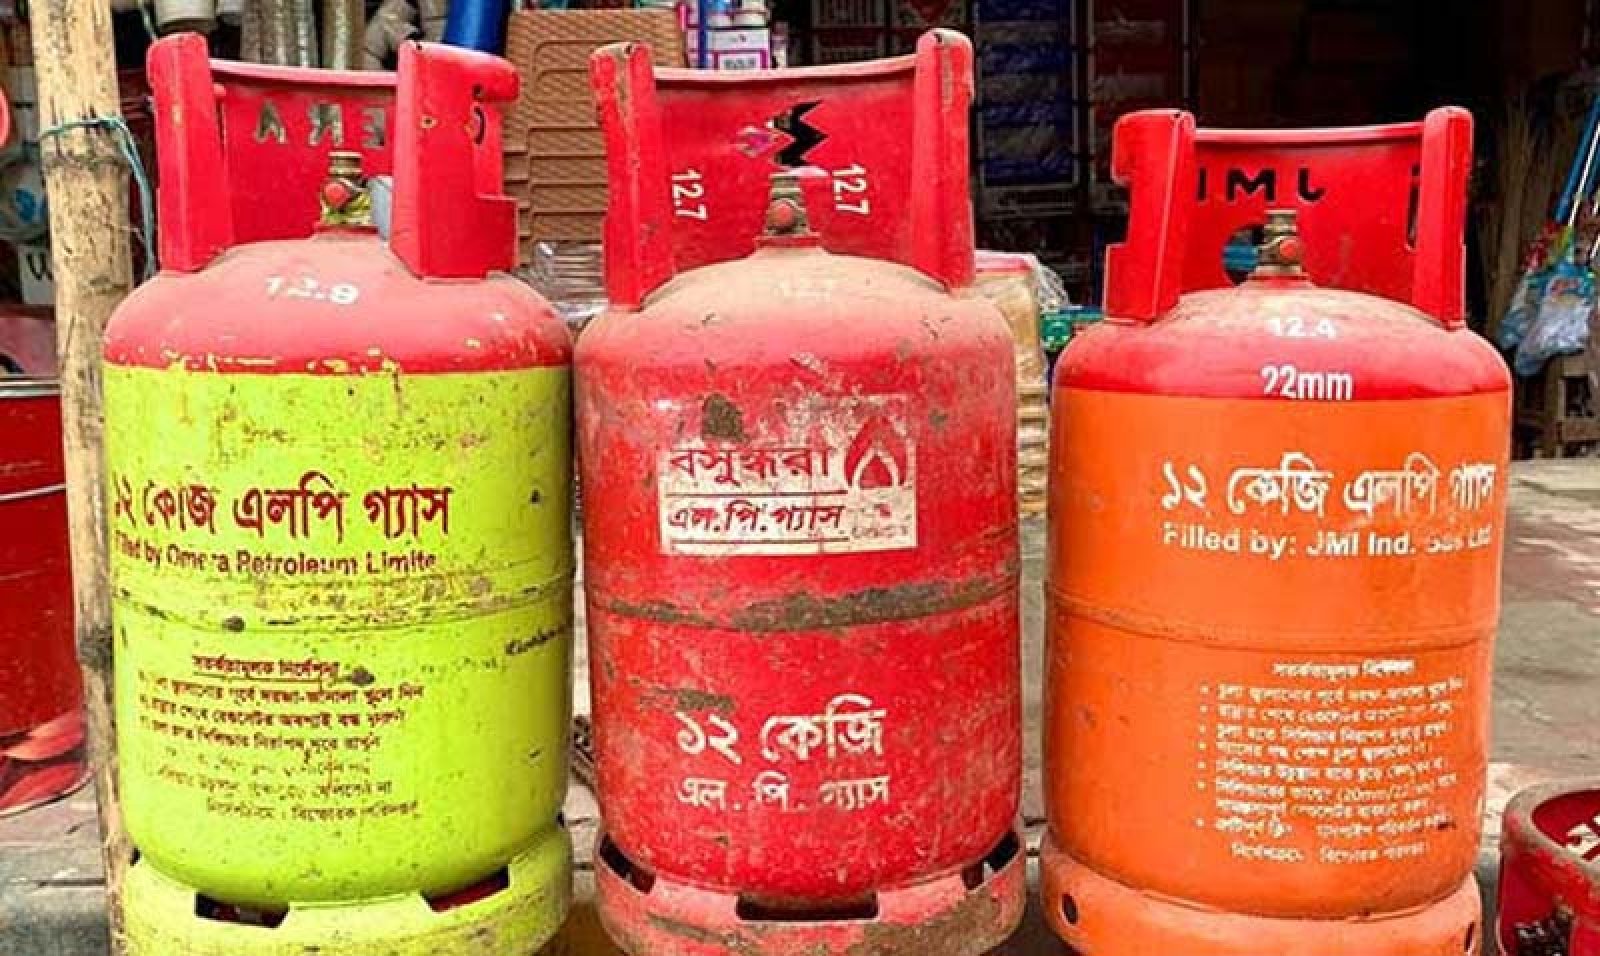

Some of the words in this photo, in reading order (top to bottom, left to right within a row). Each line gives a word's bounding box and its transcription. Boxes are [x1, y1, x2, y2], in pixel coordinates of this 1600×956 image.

[672, 169, 708, 221] 12.7
[832, 163, 870, 215] 12.7
[232, 471, 350, 545] এলপি
[363, 483, 454, 538] গ্যাস
[1227, 451, 1335, 518] কেজি
[1306, 530, 1359, 556] JMI
[674, 710, 743, 766] ১২
[758, 693, 888, 762] কেজি
[818, 775, 891, 812] গ্যাস
